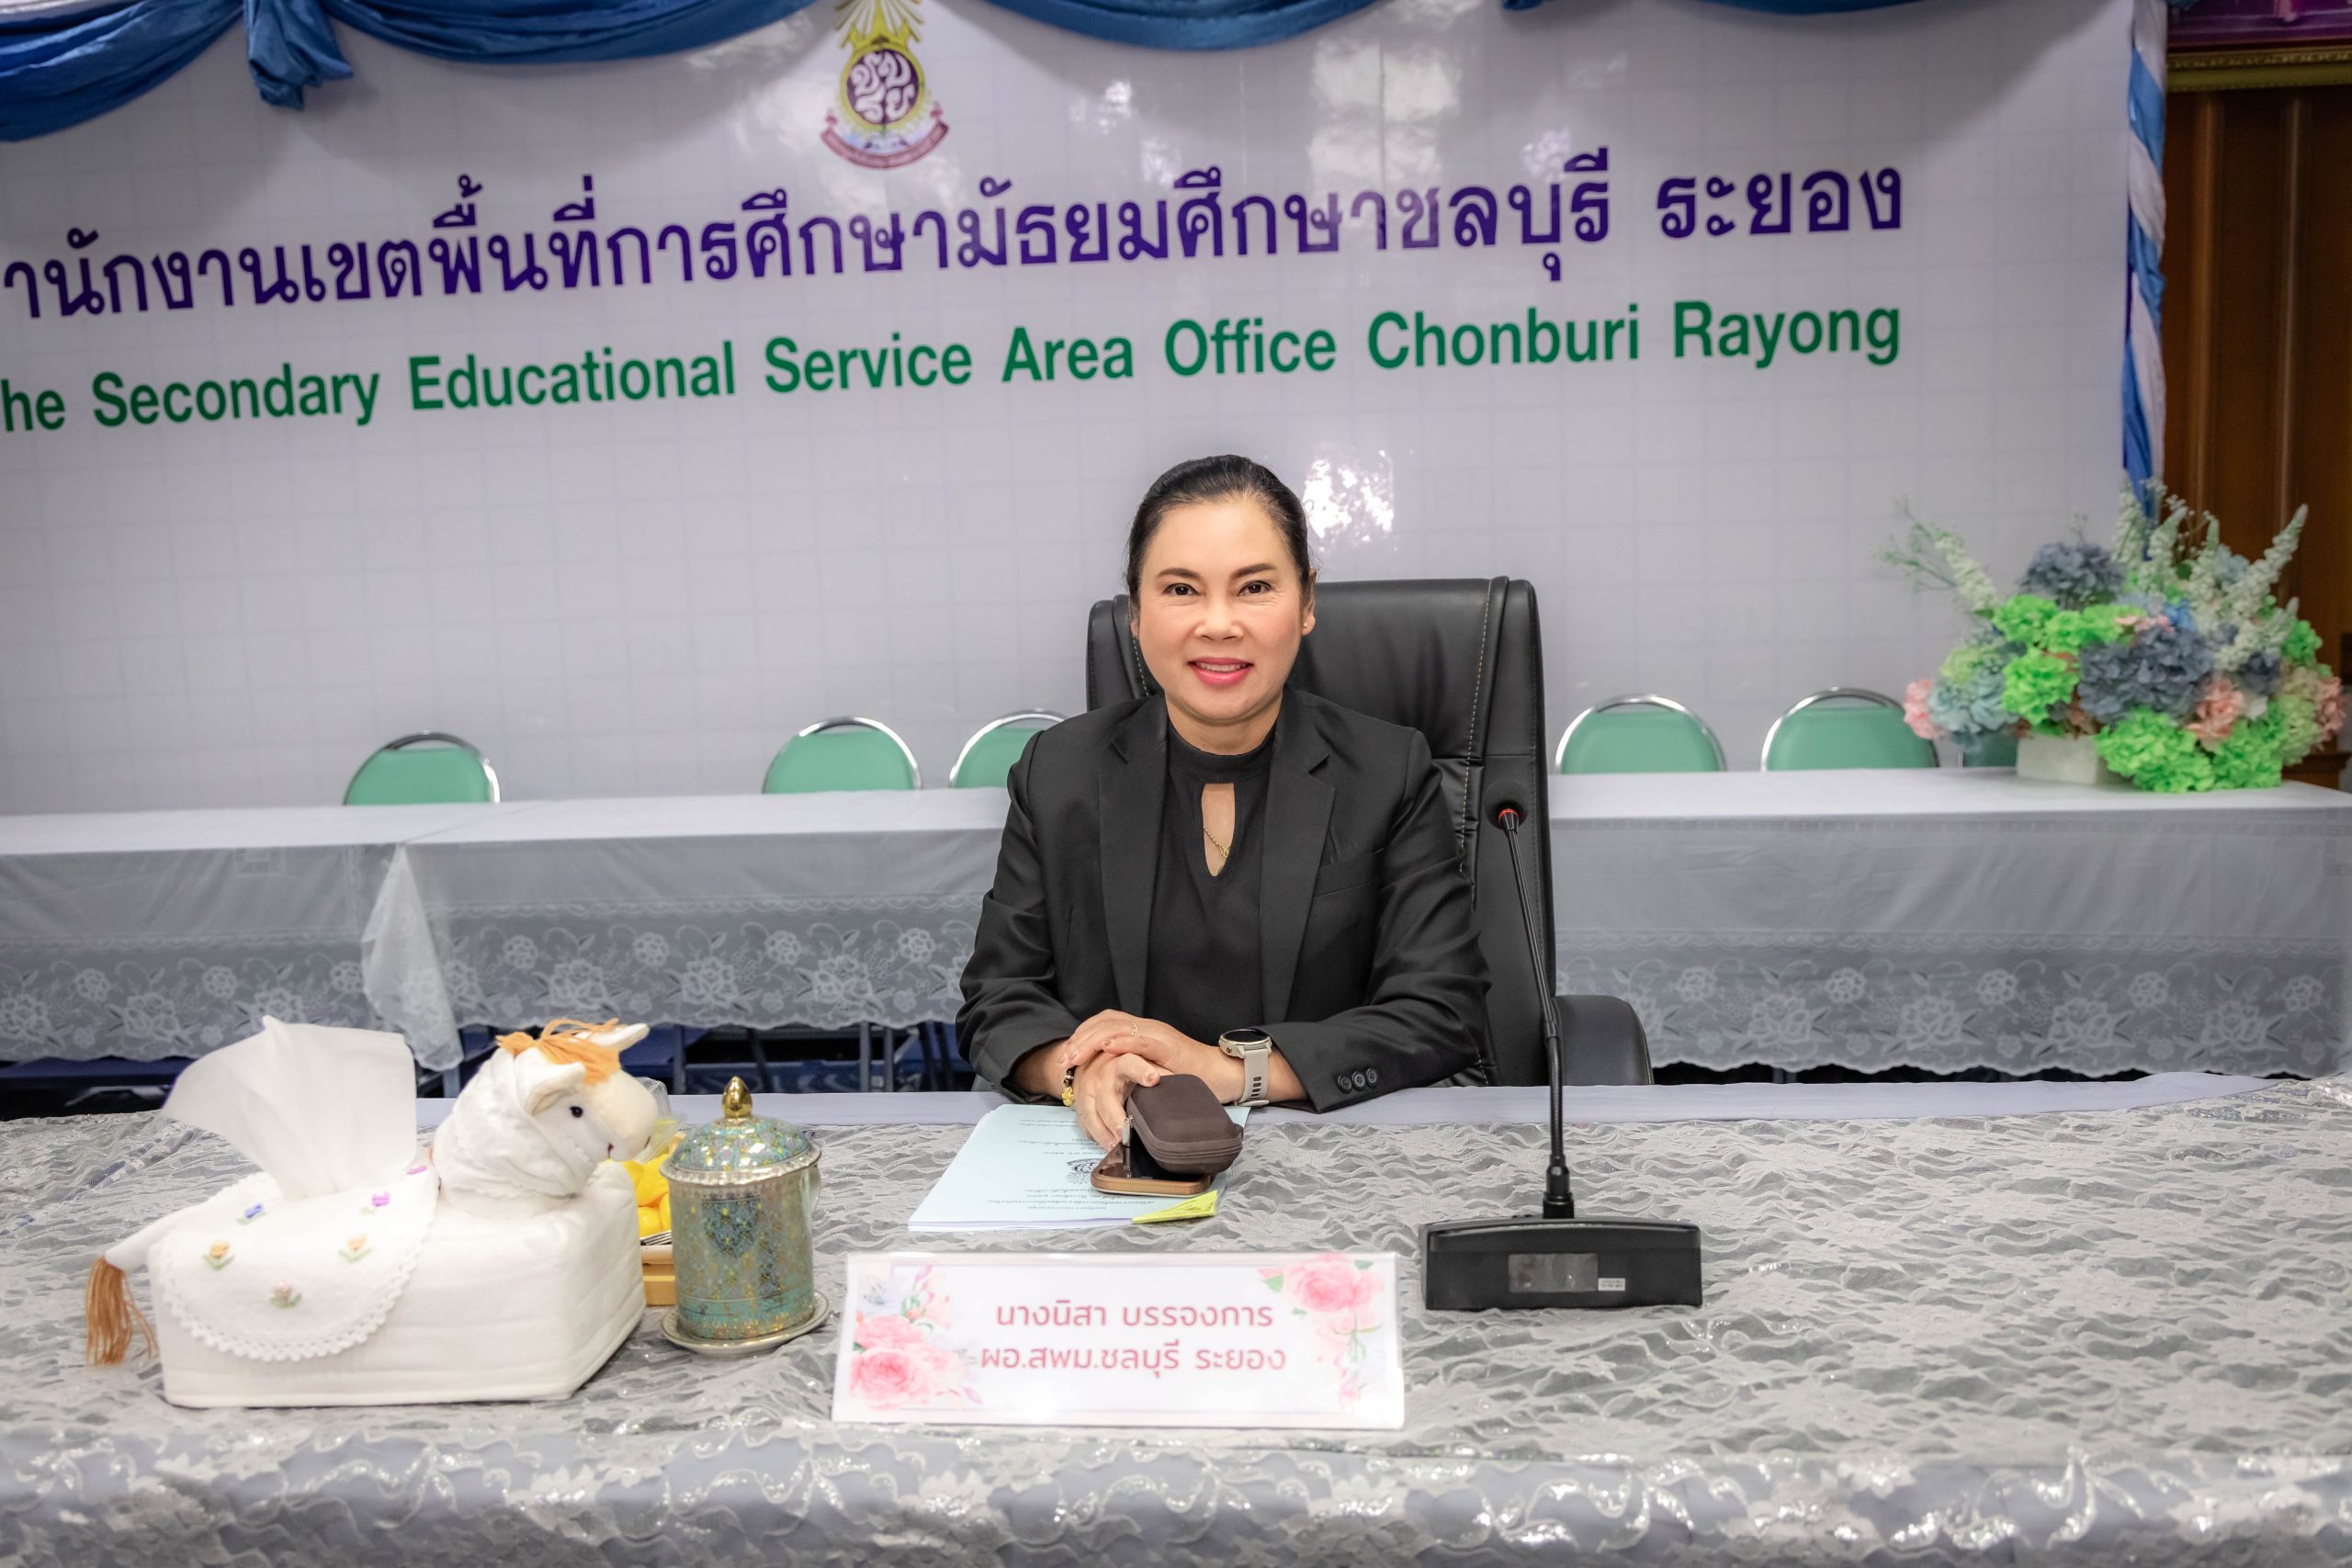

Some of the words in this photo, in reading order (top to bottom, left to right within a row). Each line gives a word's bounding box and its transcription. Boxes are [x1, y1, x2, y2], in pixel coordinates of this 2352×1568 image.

[4, 146, 1610, 319] านักงานเขตพื้นที่การศึกษามัธยมศึกษาชลบุรี
[1656, 167, 1902, 240] ระยอง
[0, 378, 65, 433] he
[92, 362, 380, 427] Secondary
[408, 341, 736, 412] Educational
[764, 332, 972, 394] Service
[1001, 325, 1134, 383] Area
[1163, 317, 1337, 378] Office
[1367, 303, 1640, 369] Chonburi
[1673, 299, 1901, 370] Rayong
[996, 1298, 1107, 1327] นางนิสา
[1122, 1304, 1273, 1327] บรรจงการ
[980, 1338, 1181, 1379] ผอ.สพม.ชลบุรี
[1194, 1348, 1287, 1371] ระยอง
